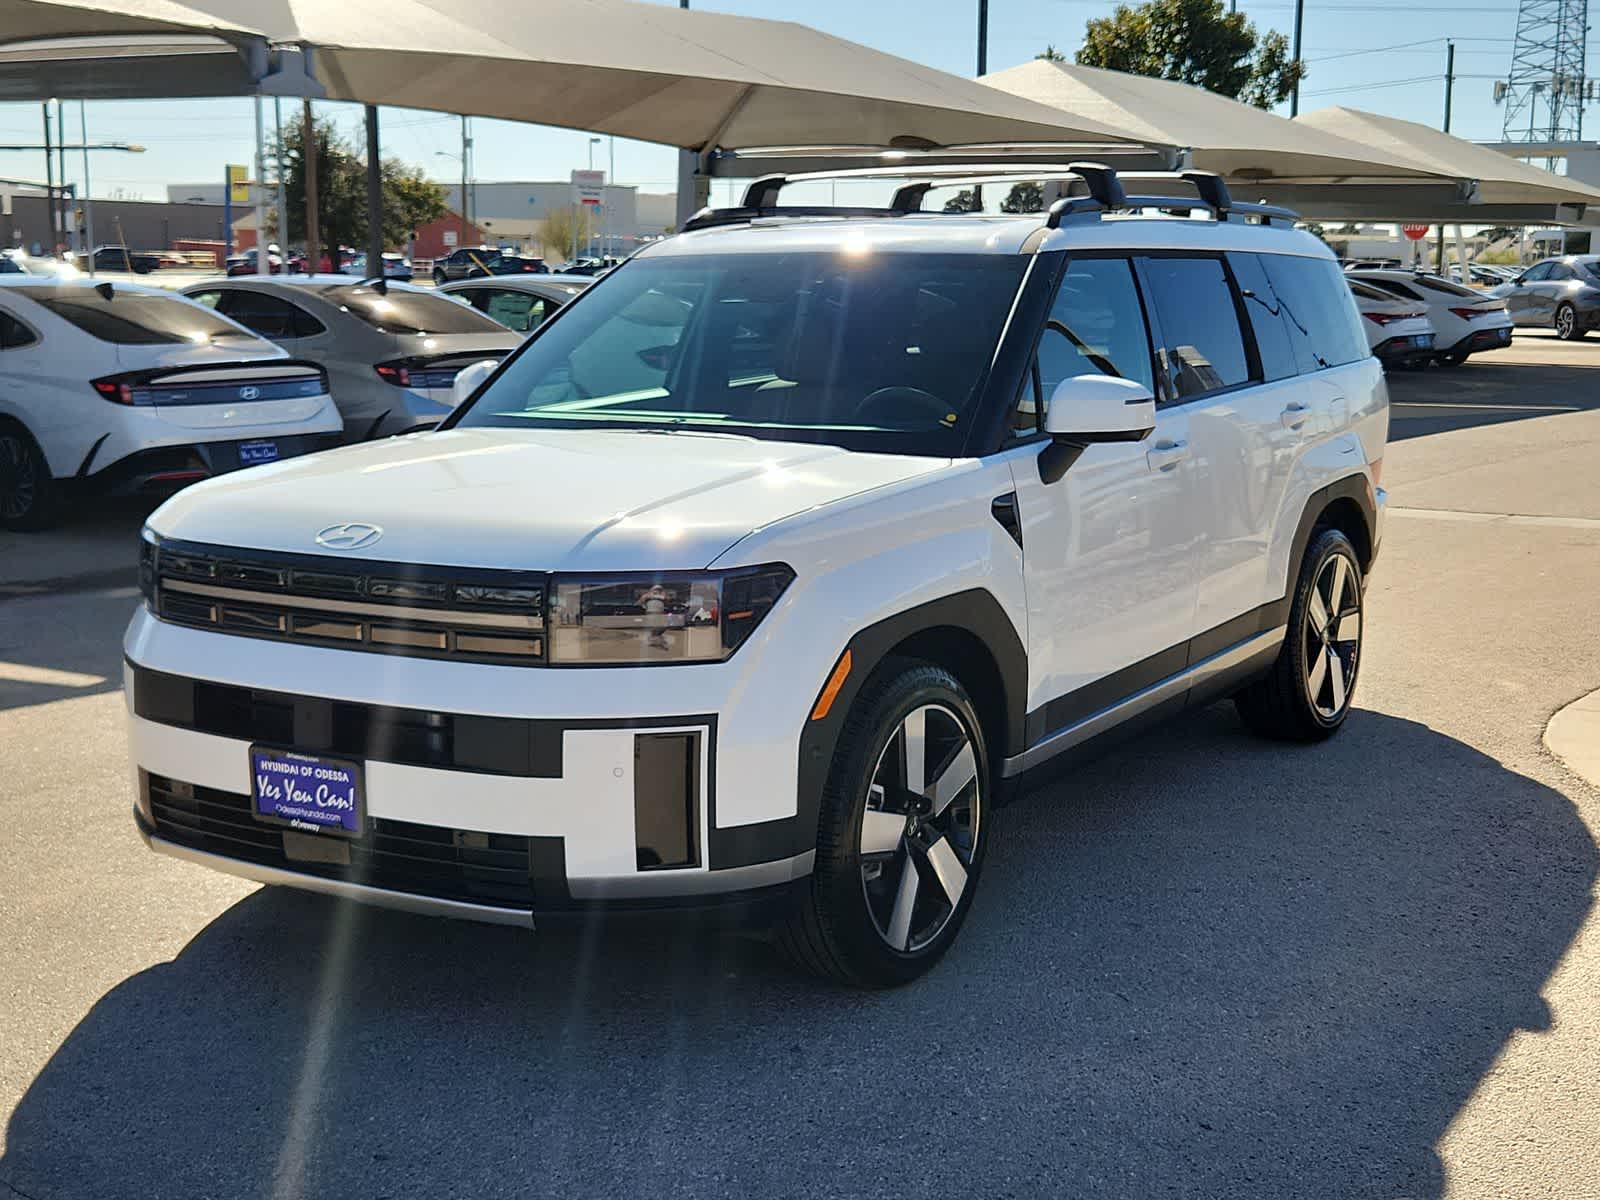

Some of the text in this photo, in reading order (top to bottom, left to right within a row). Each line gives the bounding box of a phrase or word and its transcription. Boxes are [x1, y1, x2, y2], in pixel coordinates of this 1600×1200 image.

[261, 760, 349, 783] HYUNDAI OF ODESSA
[257, 775, 354, 811] Yes You Can!
